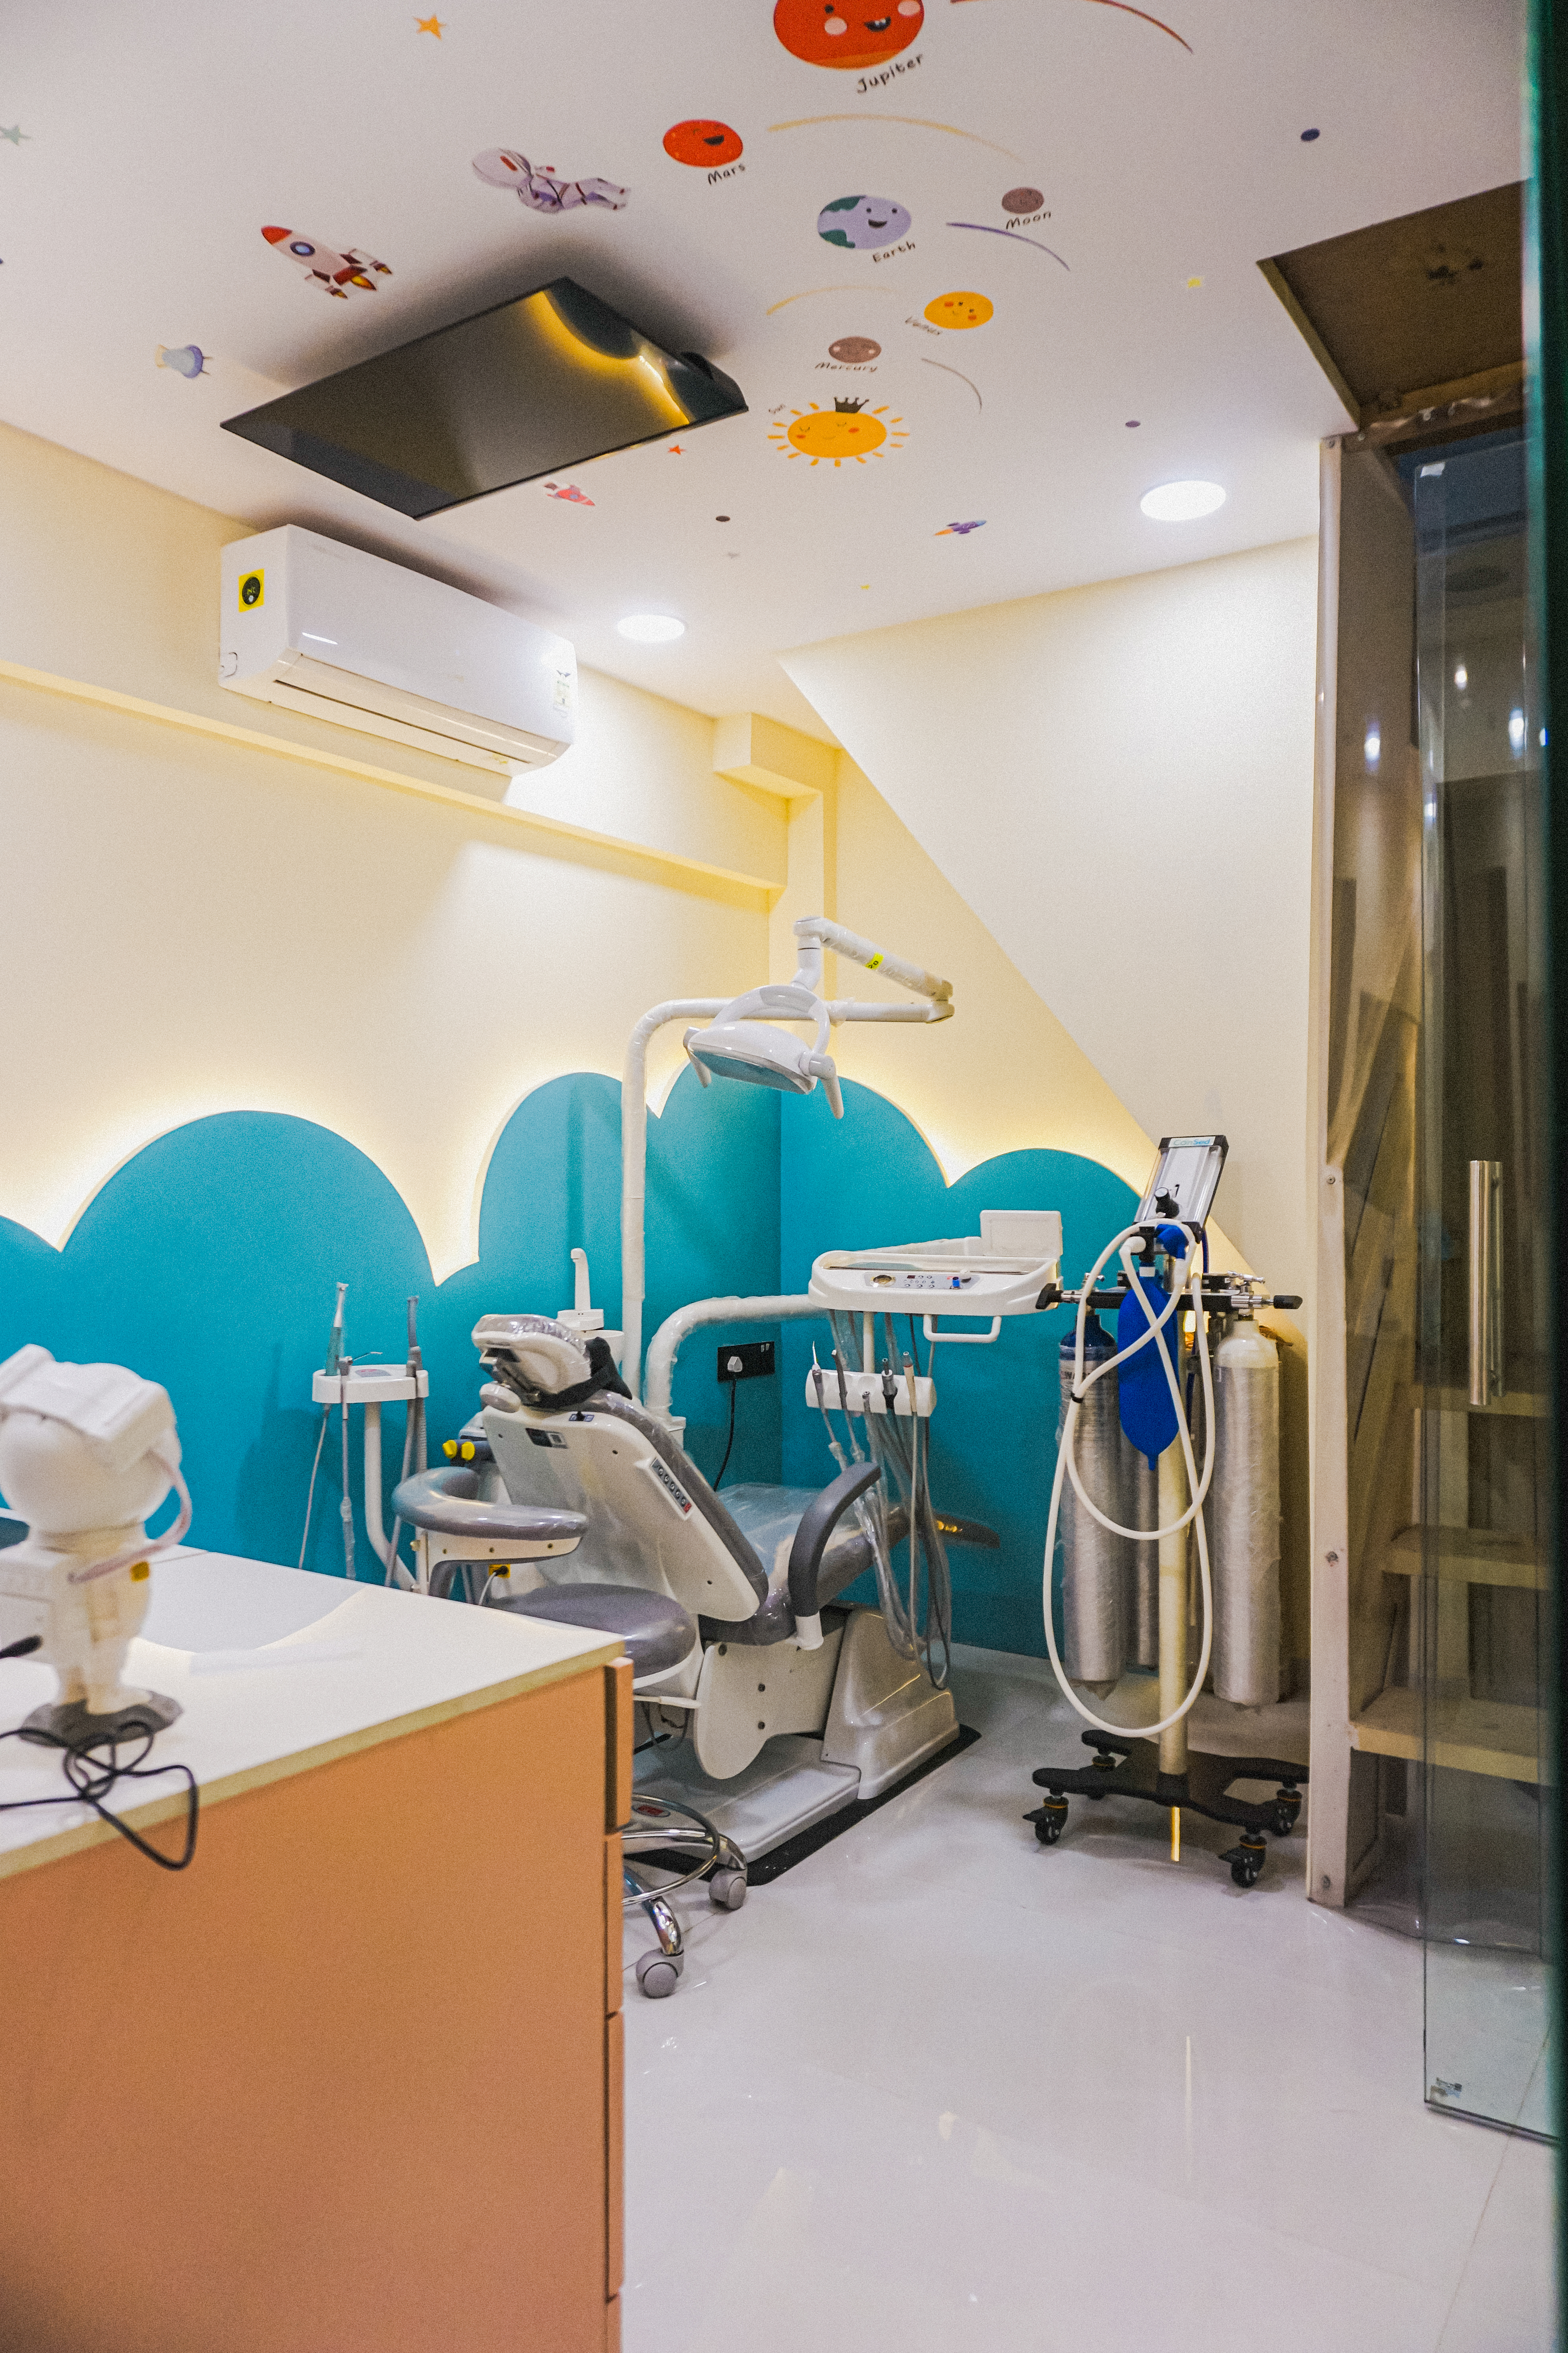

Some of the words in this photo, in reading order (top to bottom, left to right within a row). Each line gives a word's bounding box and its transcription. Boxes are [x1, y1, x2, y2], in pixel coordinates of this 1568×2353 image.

[857, 54, 923, 93] Jupiter
[708, 163, 745, 185] Mars
[1006, 211, 1051, 230] Moon
[873, 240, 916, 263] Earth
[815, 362, 878, 372] Mercury
